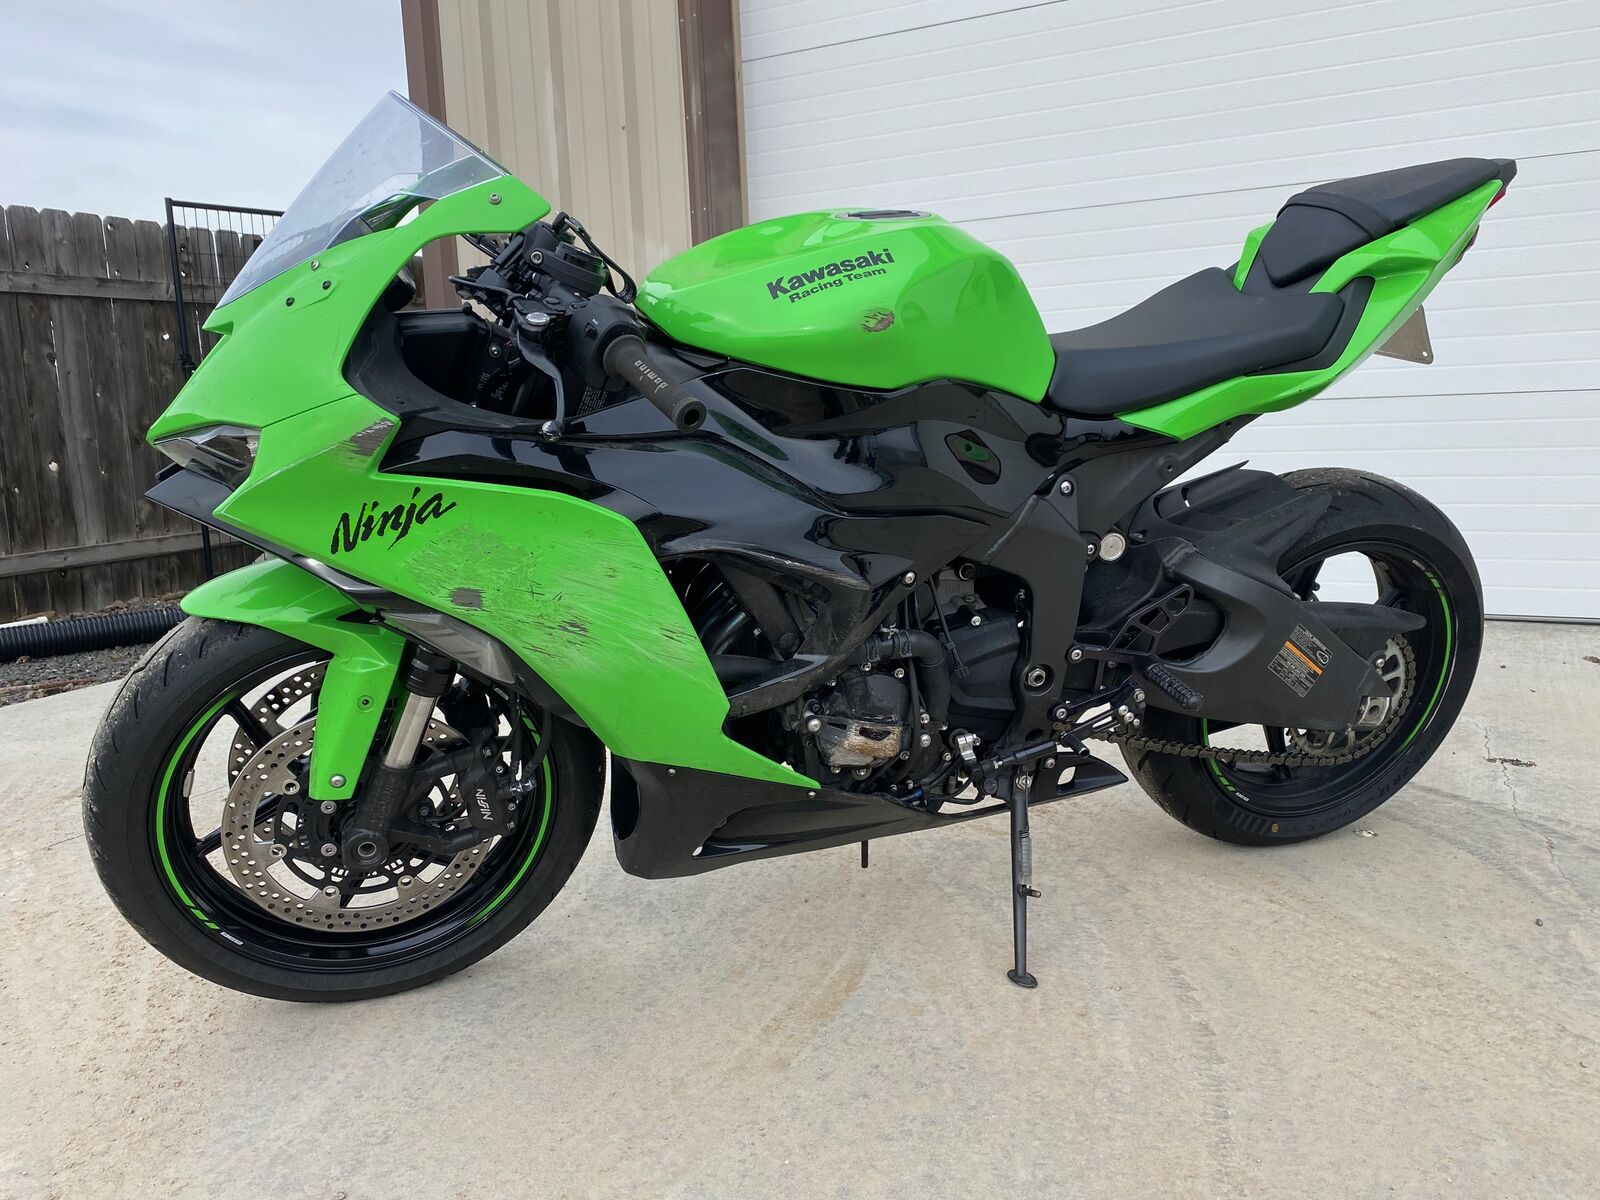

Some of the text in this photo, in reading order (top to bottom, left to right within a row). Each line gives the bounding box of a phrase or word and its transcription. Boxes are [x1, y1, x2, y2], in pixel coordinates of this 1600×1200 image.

[766, 248, 895, 300] Kawasaki
[788, 268, 887, 303] Racing Team
[634, 359, 669, 393] domino
[330, 486, 458, 555] Ninja
[475, 788, 494, 821] NISSIN
